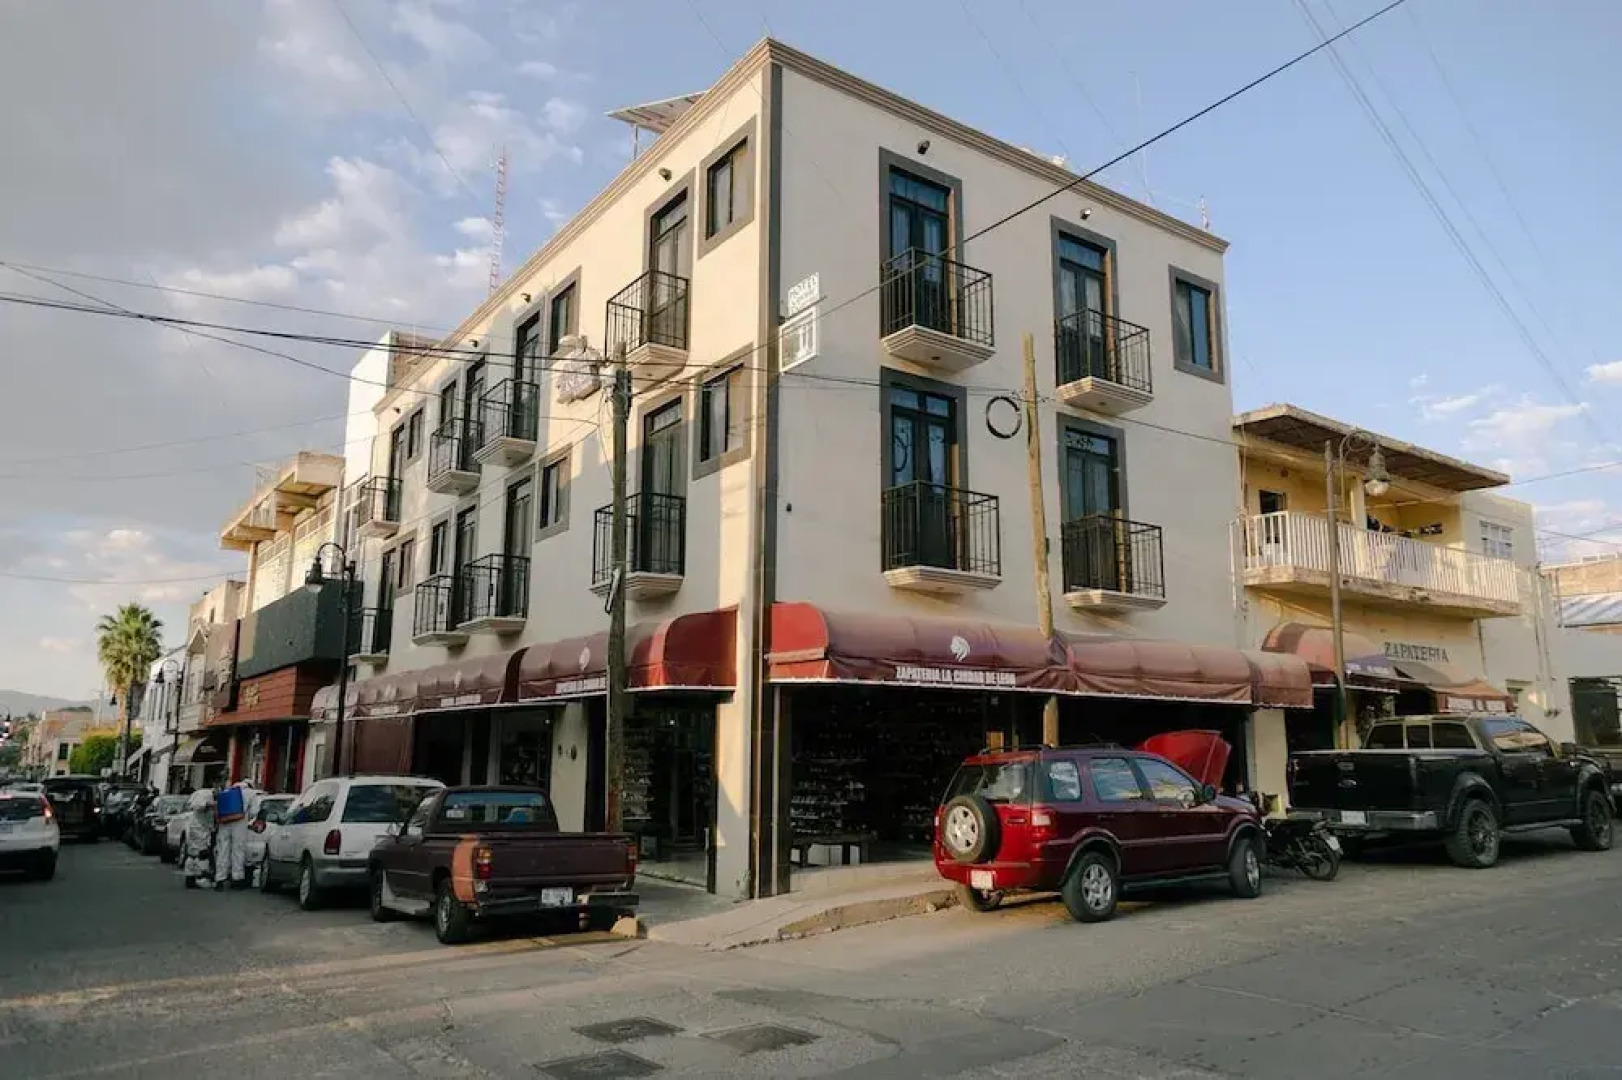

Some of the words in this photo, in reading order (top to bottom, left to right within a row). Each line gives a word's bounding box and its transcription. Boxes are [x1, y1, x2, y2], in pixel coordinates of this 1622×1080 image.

[1384, 642, 1449, 662] ZAPATERIA
[941, 669, 952, 682] LA
[985, 671, 997, 685] DE
